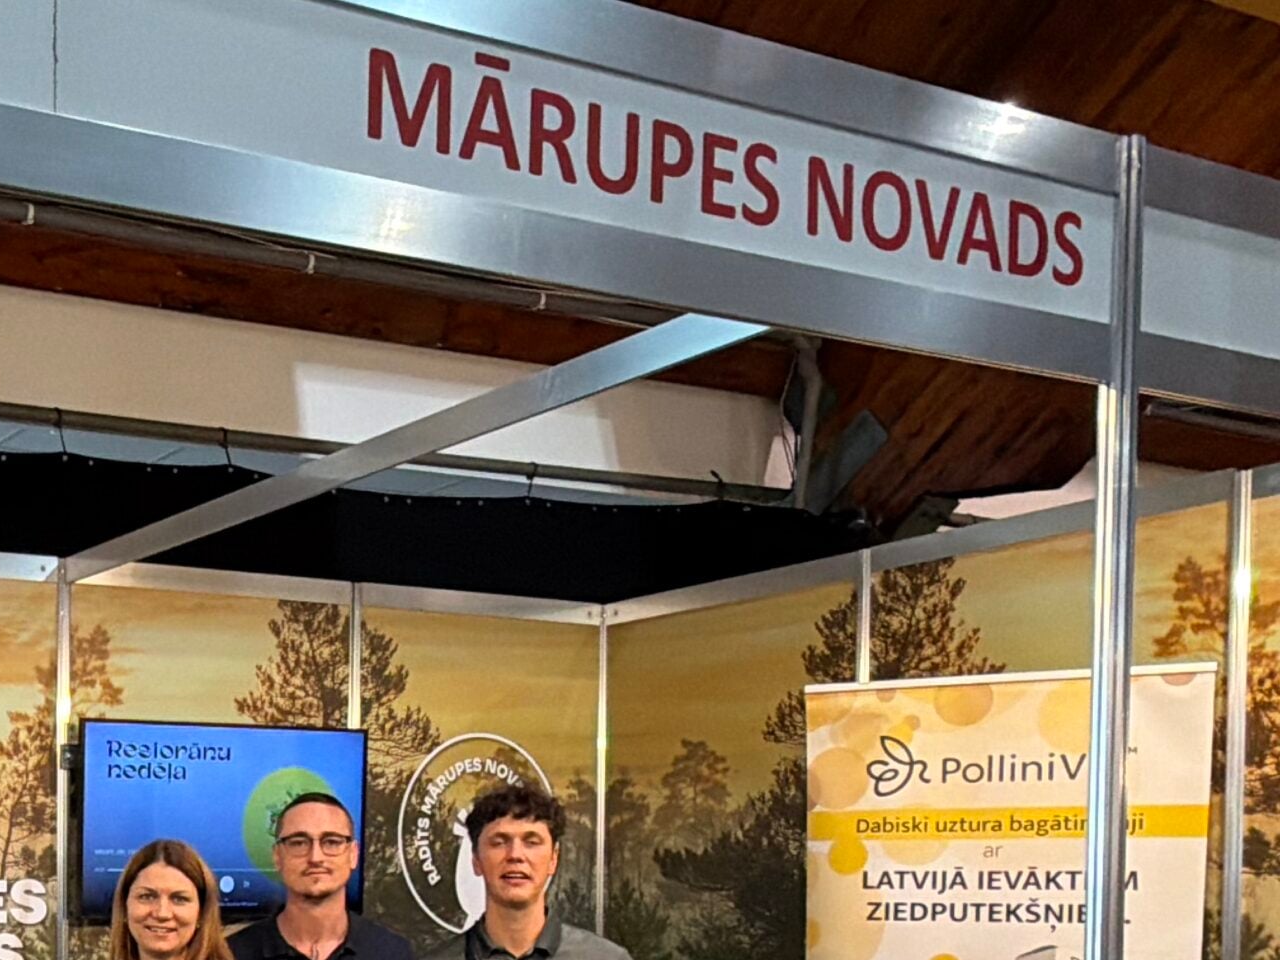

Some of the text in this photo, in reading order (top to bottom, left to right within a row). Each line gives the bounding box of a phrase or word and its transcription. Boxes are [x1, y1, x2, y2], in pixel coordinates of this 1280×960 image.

[366, 48, 1084, 287] MĀRUPES NOVADS
[941, 753, 1087, 785] PolliniV
[421, 757, 482, 816] MĀRUPES
[484, 758, 524, 788] NOV
[856, 815, 929, 834] Dabiski
[935, 817, 1003, 834] uztura
[982, 845, 1004, 859] ar
[862, 866, 1139, 895] LATVIJĀ IEVĀKTM
